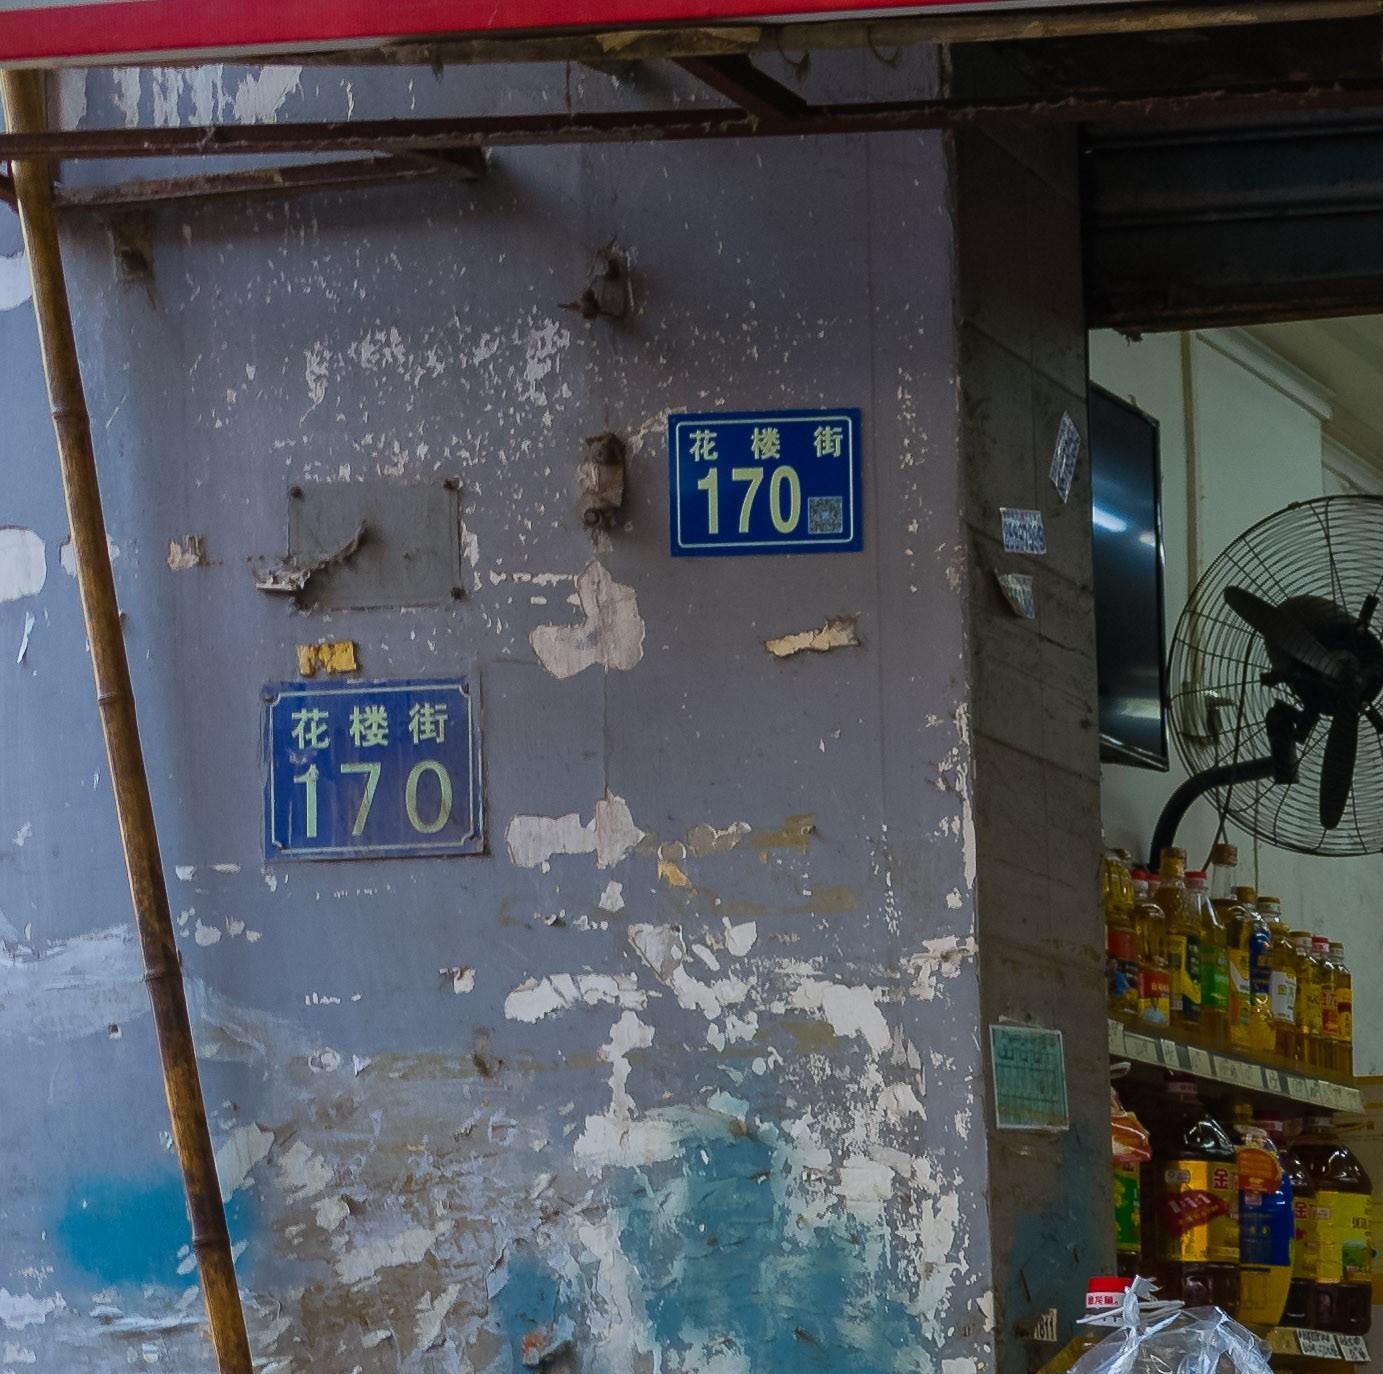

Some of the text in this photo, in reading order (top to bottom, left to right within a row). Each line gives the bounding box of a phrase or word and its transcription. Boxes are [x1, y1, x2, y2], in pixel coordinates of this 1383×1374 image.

[690, 426, 843, 462] 花楼街
[697, 465, 802, 535] 170
[291, 702, 449, 750] 花楼街
[293, 760, 454, 838] 170
